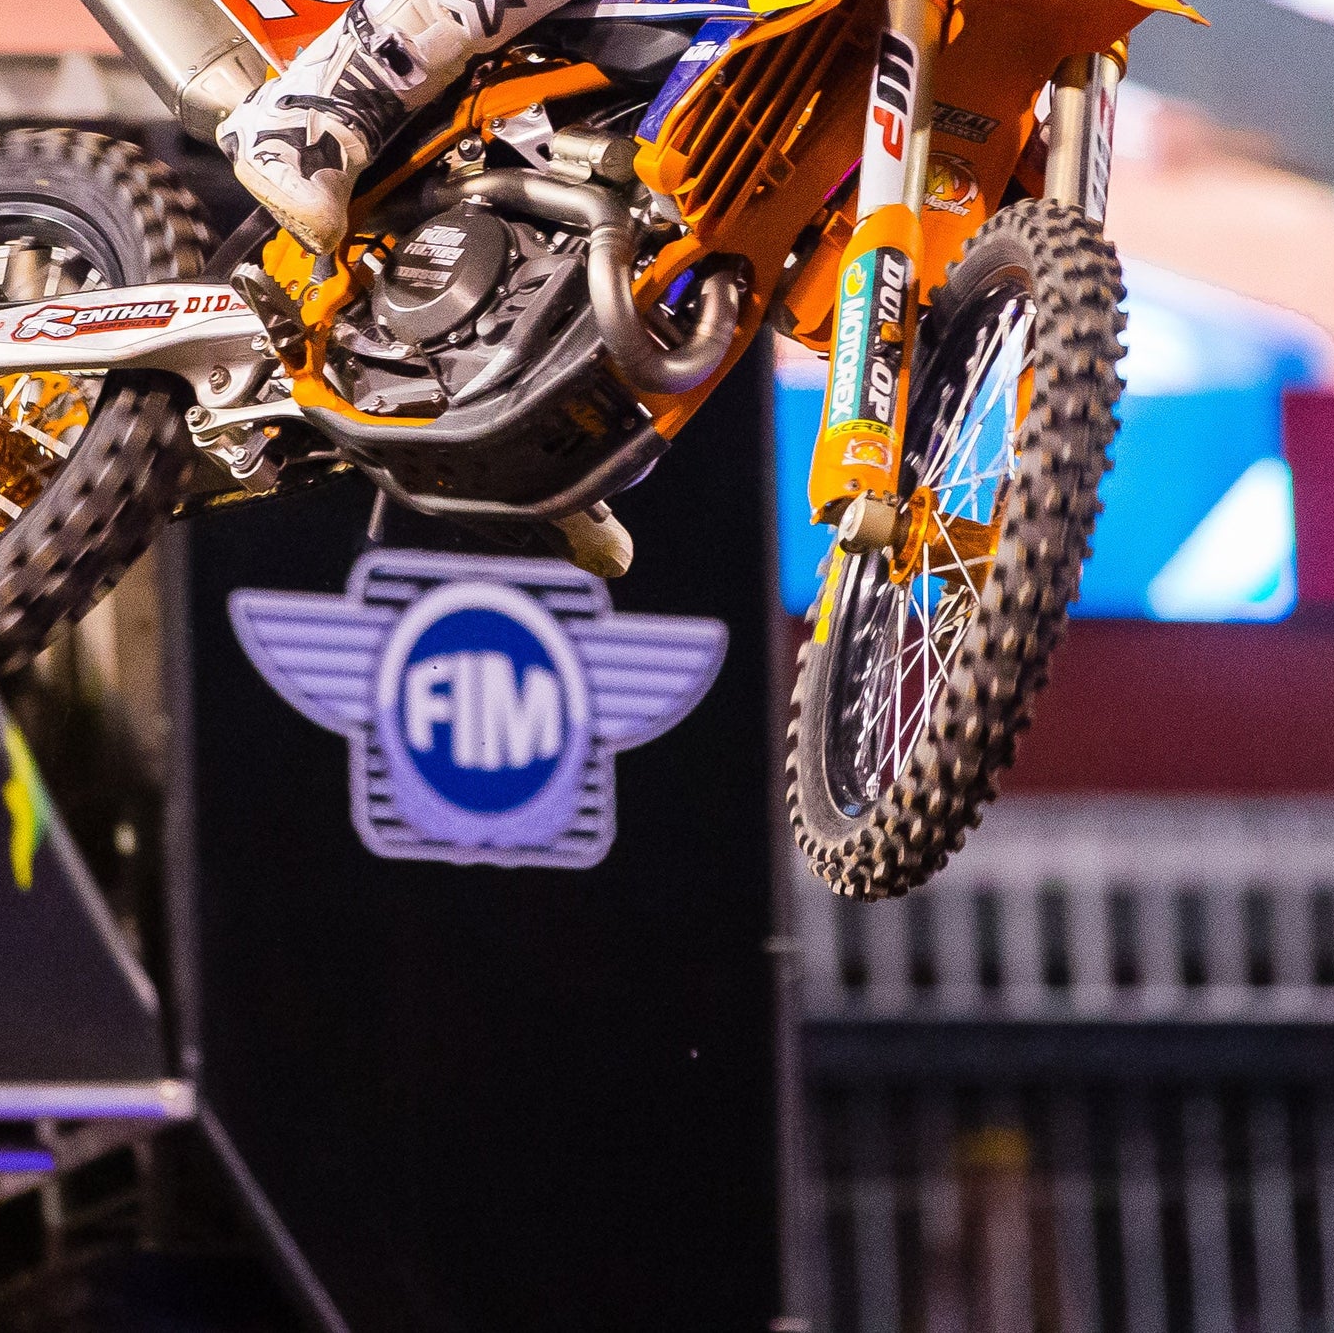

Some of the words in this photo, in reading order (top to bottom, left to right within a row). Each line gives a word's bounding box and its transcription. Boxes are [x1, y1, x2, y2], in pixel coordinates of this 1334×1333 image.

[415, 225, 467, 247] KTM
[14, 302, 173, 339] RENTHAL
[830, 297, 866, 422] MOTOREX
[867, 253, 907, 423] DUOP
[407, 650, 562, 771] FIM
